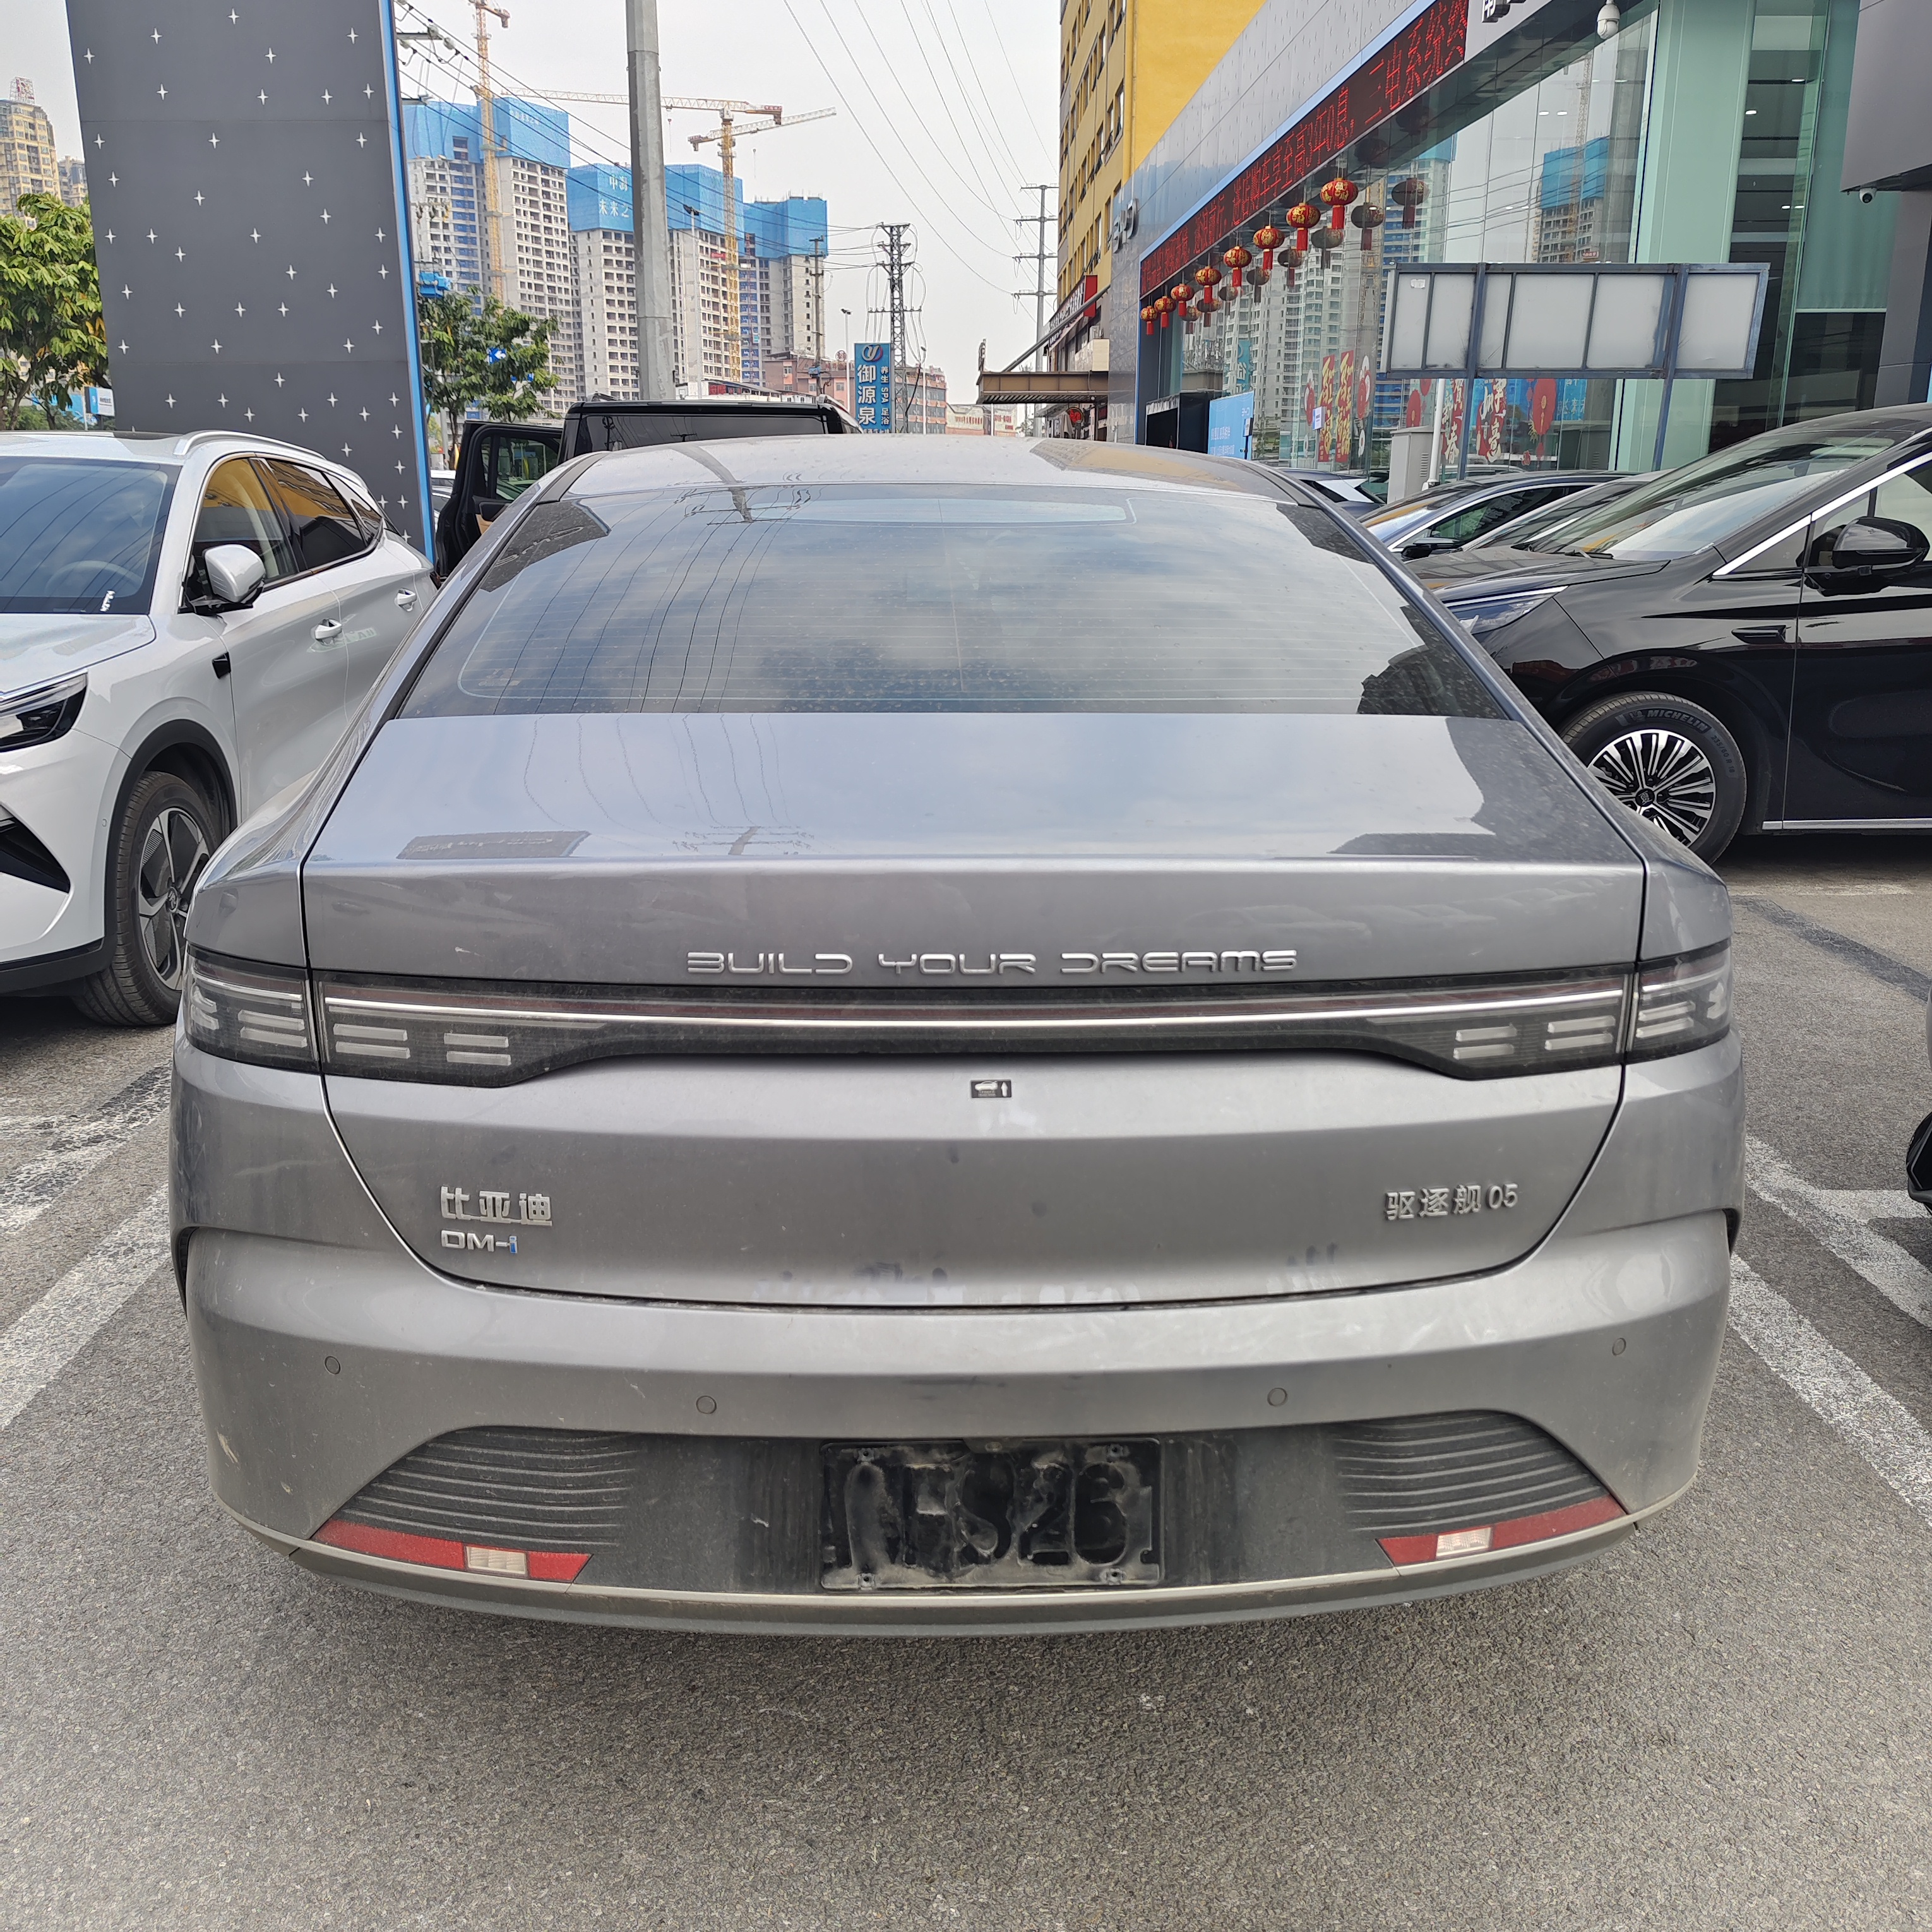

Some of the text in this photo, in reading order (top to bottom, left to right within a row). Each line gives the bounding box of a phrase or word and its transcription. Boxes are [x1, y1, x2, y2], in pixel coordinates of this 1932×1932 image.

[881, 366, 889, 383] 养生
[857, 364, 876, 425] 御源泉
[881, 408, 890, 425] 足浴
[1647, 710, 1708, 732] MICHELIN
[687, 950, 1298, 974] BUILD YOUR DREAMS
[441, 1186, 552, 1226] 比亚迪
[1386, 1183, 1518, 1220] 驱逐舰 05
[441, 1230, 518, 1254] DM-i
